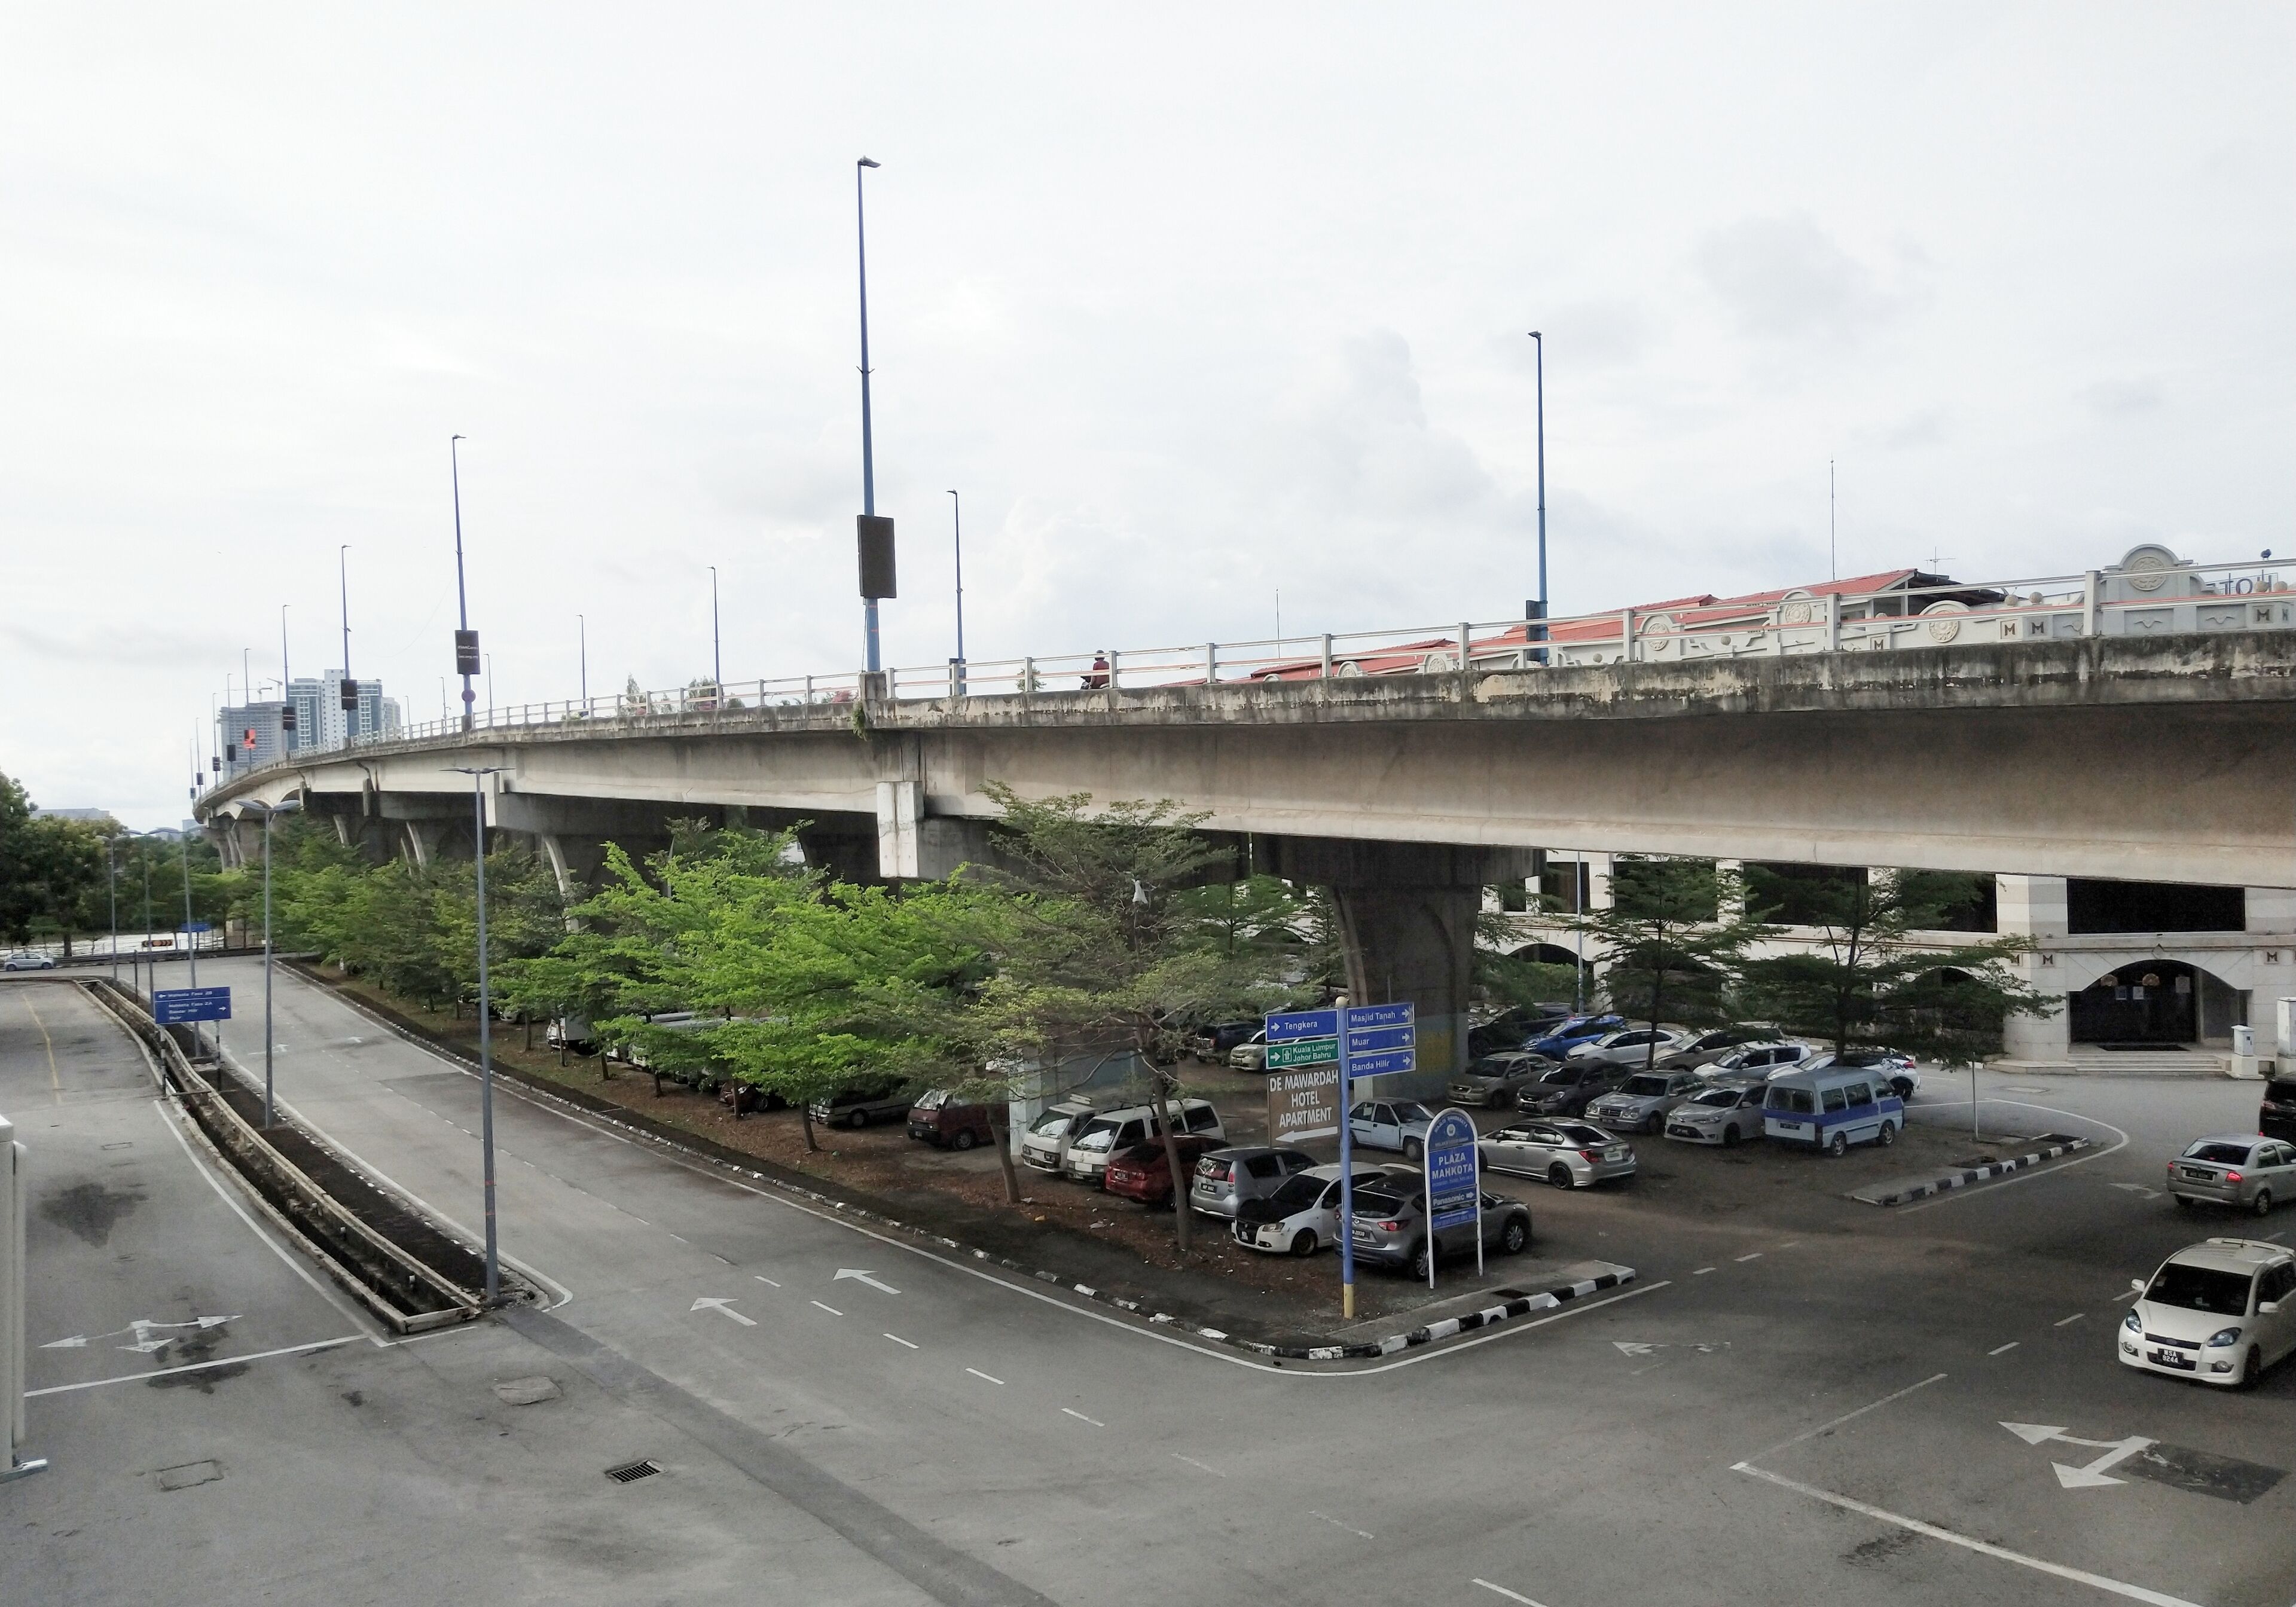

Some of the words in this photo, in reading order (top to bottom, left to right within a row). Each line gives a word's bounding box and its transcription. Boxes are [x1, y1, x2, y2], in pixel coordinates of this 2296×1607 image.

[1351, 1013, 1374, 1023] Masjid
[1375, 1010, 1396, 1020] Tanah
[1284, 1020, 1318, 1031] Tengkera
[1312, 1043, 1336, 1052] Lumpur
[1352, 1038, 1370, 1047] Muar
[1293, 1053, 1312, 1062] Johor
[1313, 1051, 1332, 1060] Bahru
[1352, 1062, 1374, 1071] Banda
[1269, 1077, 1282, 1092] DE
[1284, 1070, 1339, 1090] MAWARDAH
[1292, 1090, 1320, 1108] HOTEL
[1279, 1107, 1332, 1128] APARTMENT
[1438, 1152, 1466, 1166] PLAZA
[1431, 1163, 1473, 1180] MAHKOTA
[1433, 1193, 1465, 1206] Panasonic
